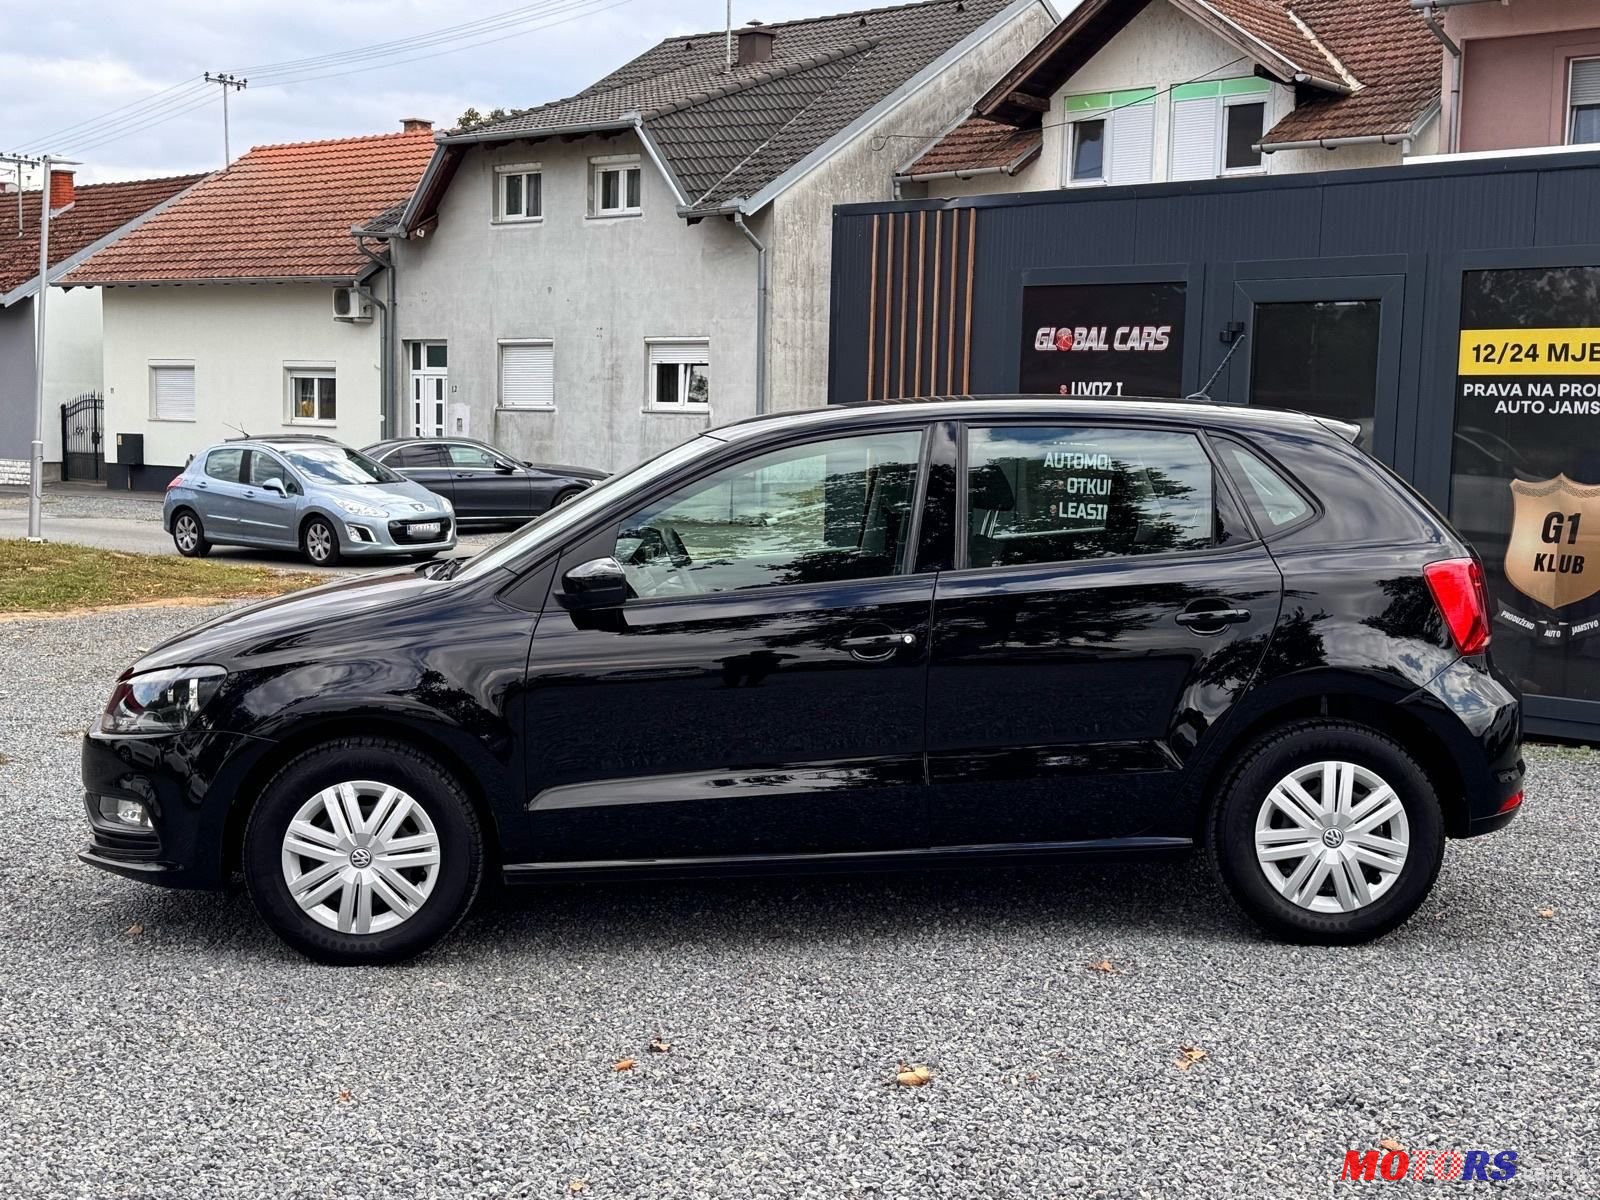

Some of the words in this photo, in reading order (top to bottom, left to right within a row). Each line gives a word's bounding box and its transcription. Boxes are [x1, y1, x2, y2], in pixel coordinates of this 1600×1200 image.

[1034, 326, 1110, 351] GLOBAL
[1113, 325, 1172, 351] CARS
[1472, 342, 1540, 364] 12/24
[1463, 383, 1523, 397] PRAVA
[1527, 383, 1555, 397] NA
[1559, 383, 1600, 397] PRO
[1494, 401, 1545, 414] AUTO
[1541, 511, 1582, 545] G1
[1533, 553, 1585, 574] KLUB
[1544, 629, 1561, 638] AUTO
[1571, 619, 1600, 636] JAMSTVO
